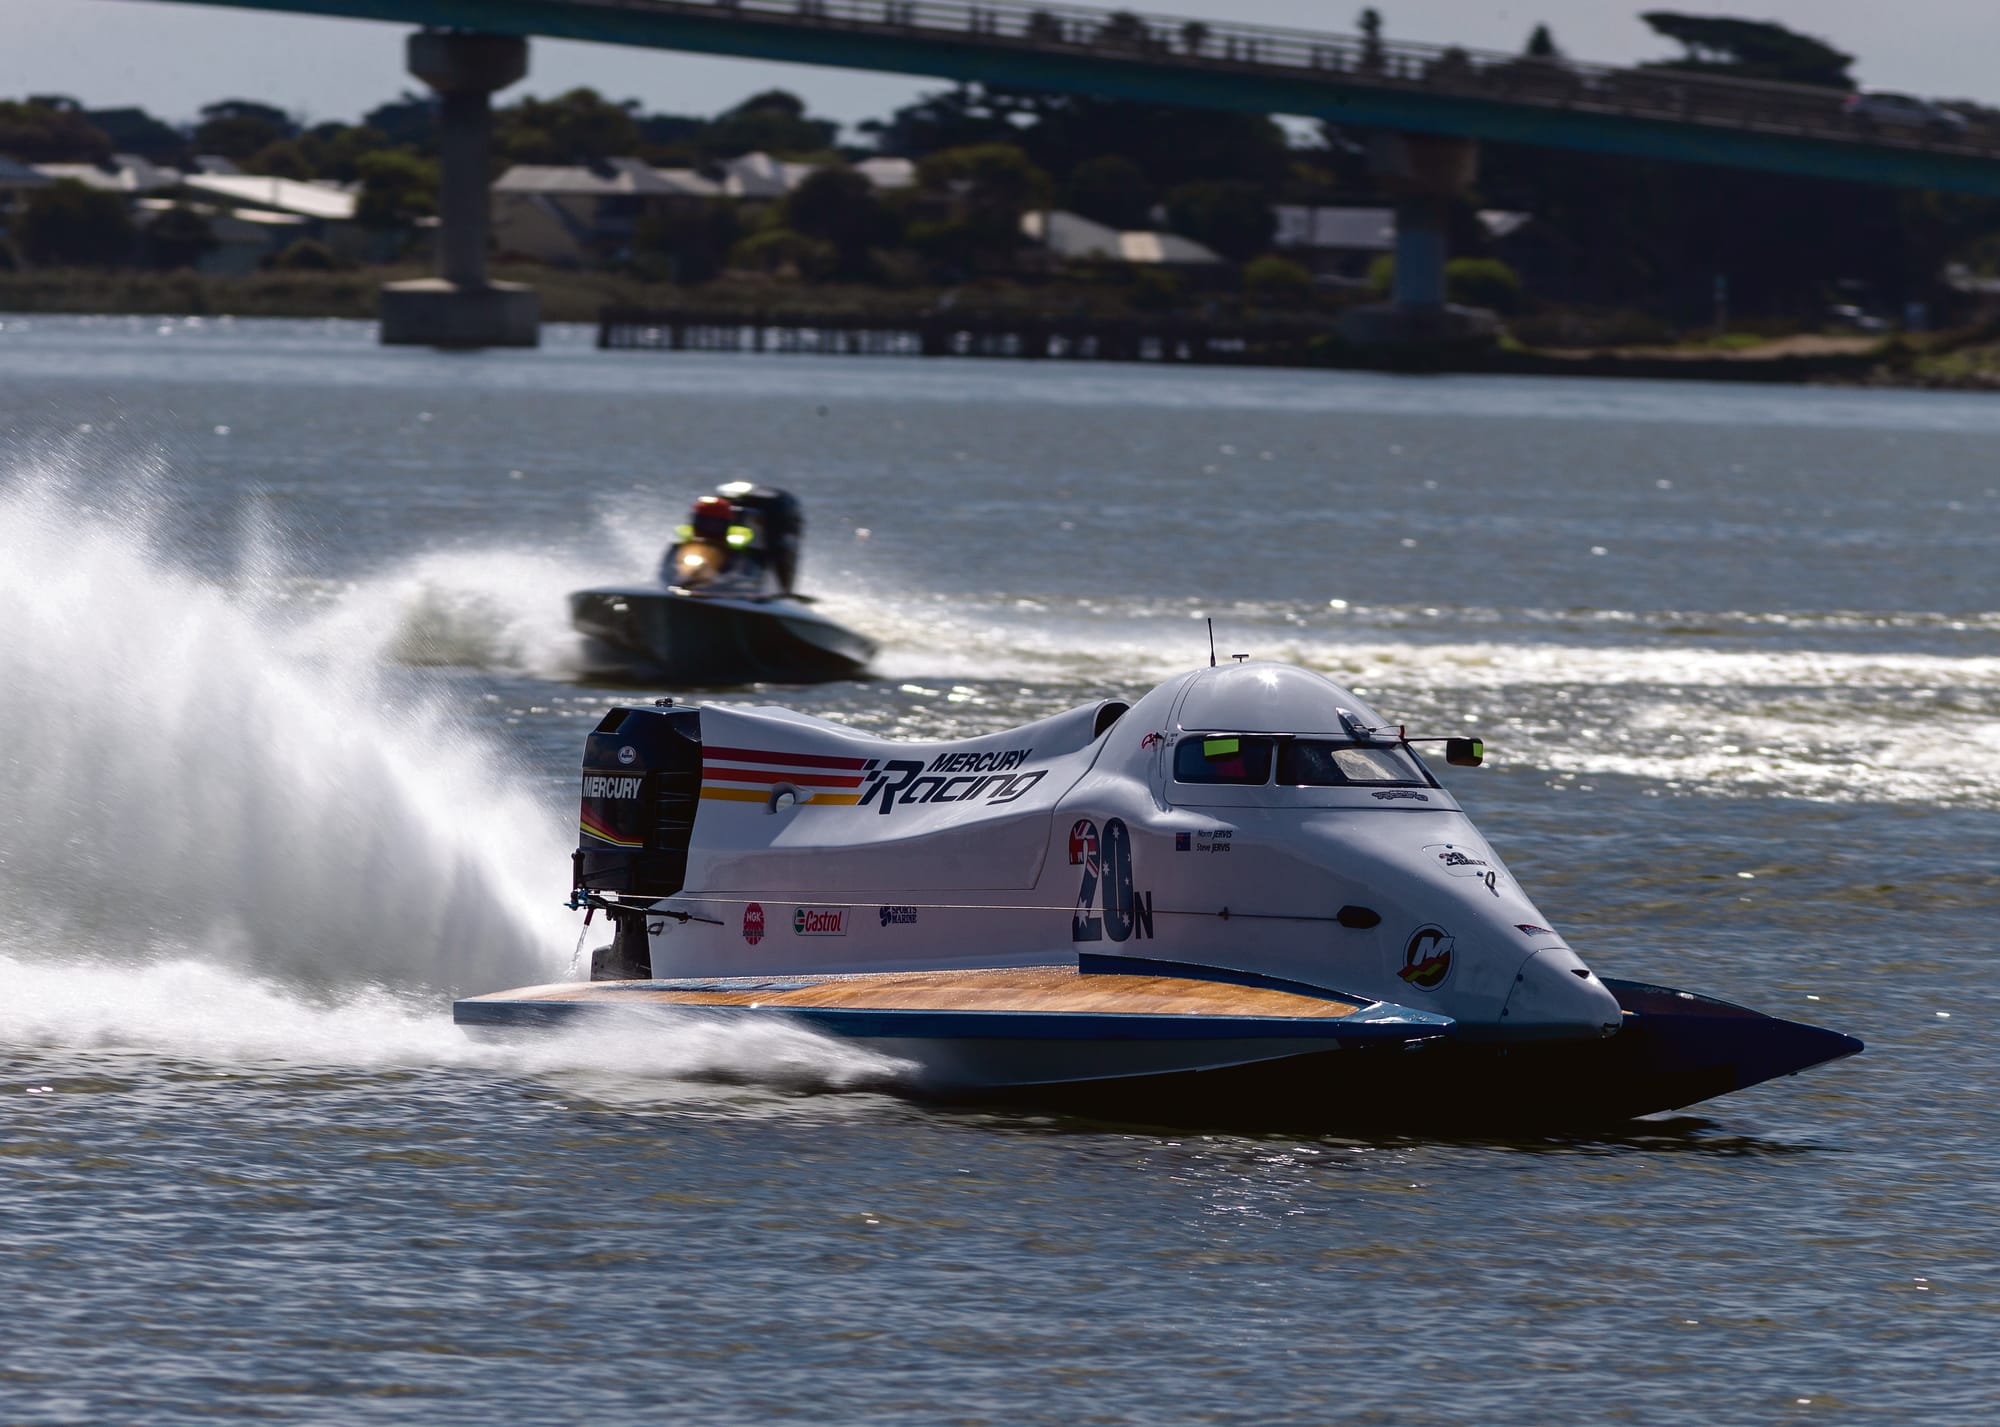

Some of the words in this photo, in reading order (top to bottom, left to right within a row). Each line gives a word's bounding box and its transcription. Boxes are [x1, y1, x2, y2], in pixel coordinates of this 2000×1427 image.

[926, 748, 1033, 774] MERCURY
[583, 776, 642, 800] MERCURY
[858, 754, 1049, 815] Racing
[1212, 829, 1233, 840] JERVIS
[1211, 843, 1231, 853] JERVIS
[746, 911, 762, 923] NGK
[805, 910, 842, 932] Castrol
[891, 914, 918, 924] MARINE
